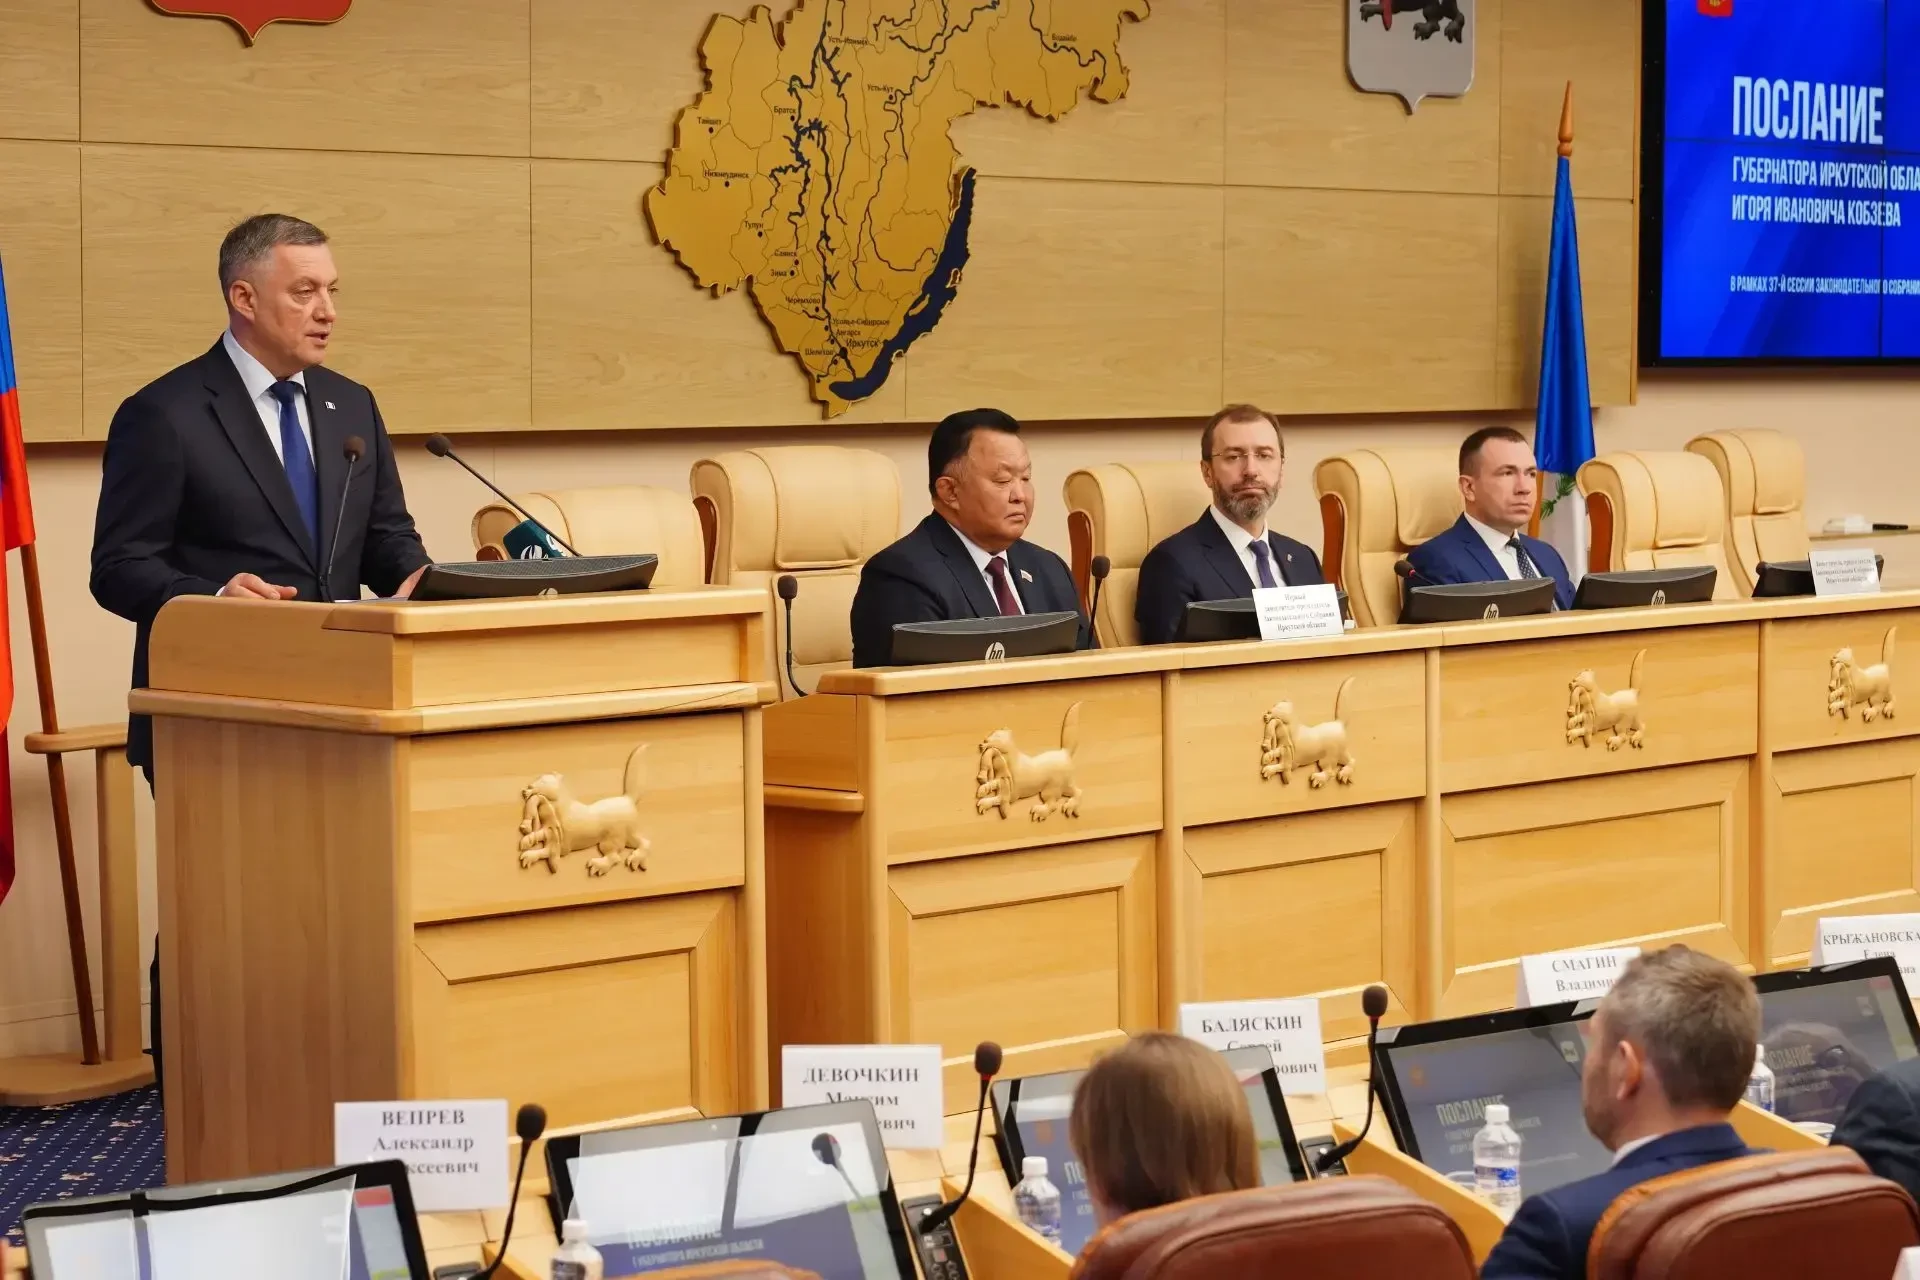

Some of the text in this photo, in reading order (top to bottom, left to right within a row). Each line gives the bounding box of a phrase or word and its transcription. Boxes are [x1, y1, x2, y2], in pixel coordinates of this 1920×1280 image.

[867, 84, 894, 94] Усть-Кут
[773, 105, 796, 115] Братск
[1733, 75, 1884, 145] ПОСЛАНИЕ
[704, 169, 750, 180] Нижнеудинск
[1732, 156, 1817, 186] ГУБЕРНАТОРА
[1820, 160, 1888, 190] ИРКУТСКОЙ
[1732, 194, 1901, 227] ИГОРЯ ИВАНОВИЧА КОБЗЕВА
[744, 220, 764, 230] Тулун
[770, 268, 787, 277] Зима
[1730, 275, 1736, 292] В
[1737, 275, 1768, 292] РАМКАХ
[1768, 274, 1786, 293] 37-Й
[1787, 276, 1815, 293] СЕССИИ
[836, 328, 861, 336] Ангарск
[846, 338, 879, 348] Иркутск
[1823, 931, 1920, 945] КРЫЖАНОВСКА
[1552, 955, 1617, 973] СМАГИН
[1556, 978, 1614, 992] Владими
[1202, 1015, 1302, 1033] БАЛЯСКИН
[1226, 1040, 1282, 1052] Сей
[802, 1067, 919, 1084] ДЕВОЧКИН
[381, 1109, 465, 1127] ВЕПРЕВ
[373, 1136, 474, 1152] Александр
[405, 1162, 480, 1175] ксеевич
